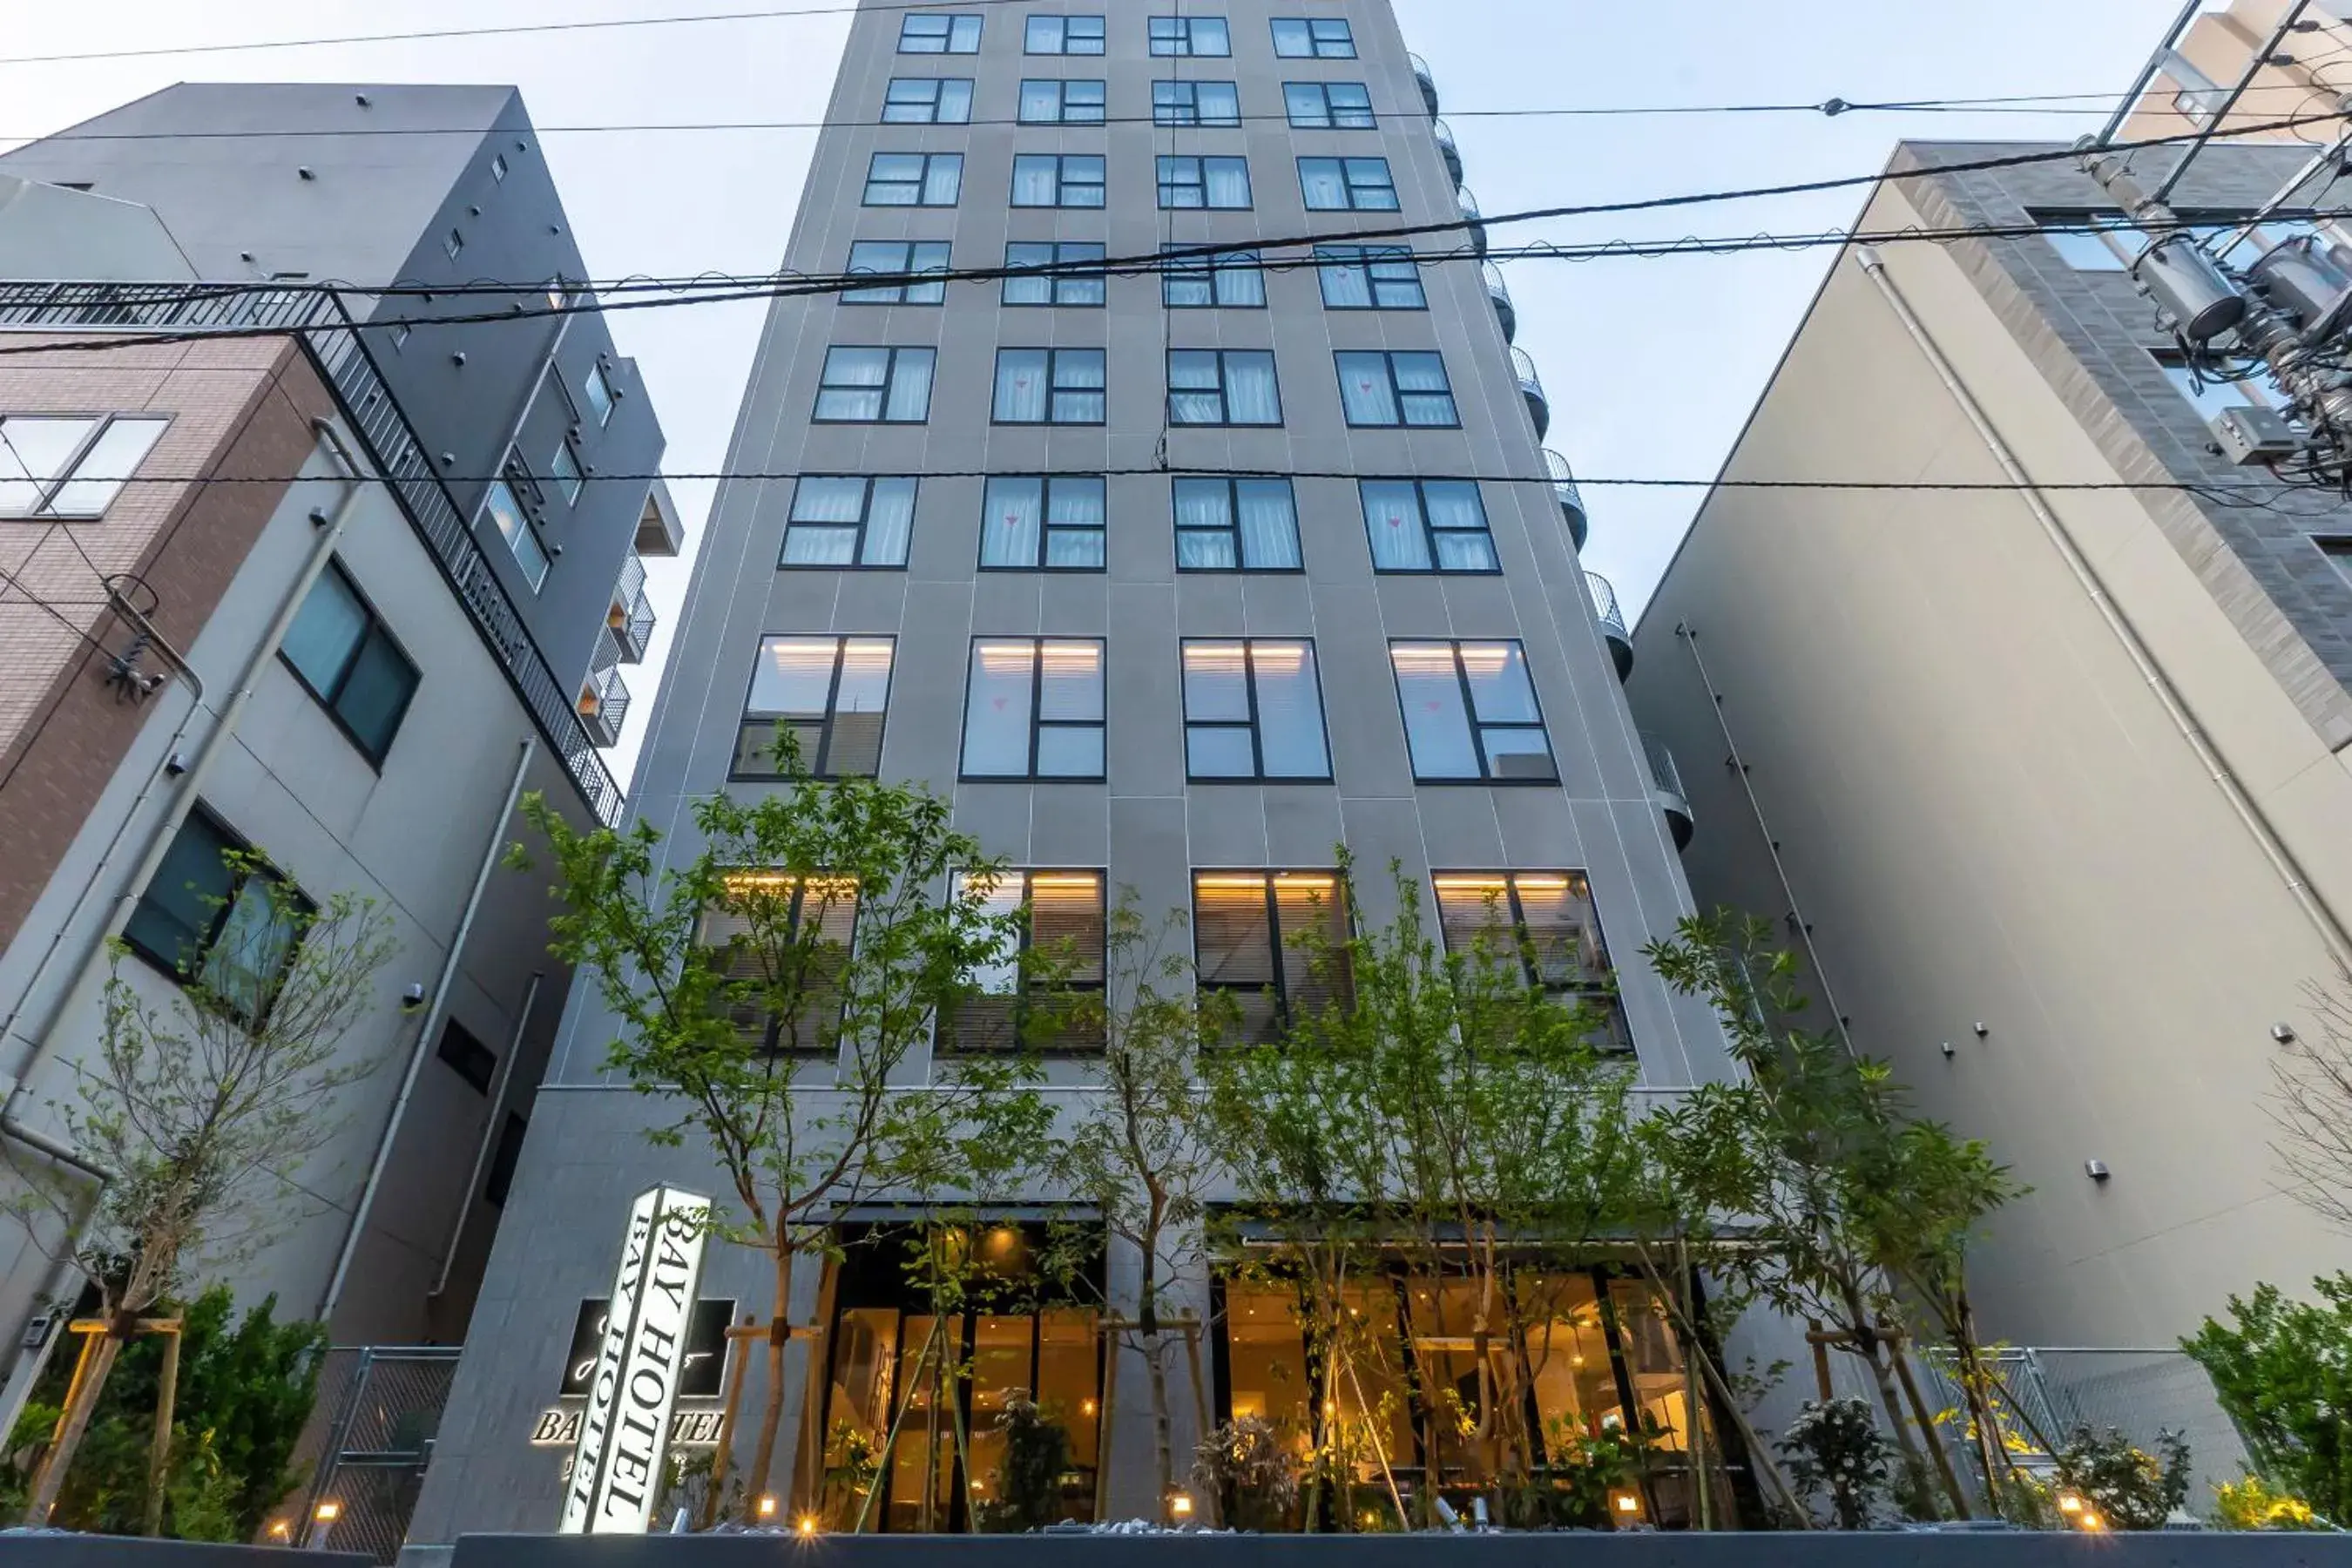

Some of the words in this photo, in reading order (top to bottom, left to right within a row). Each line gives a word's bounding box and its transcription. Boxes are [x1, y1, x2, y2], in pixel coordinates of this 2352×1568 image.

[621, 1214, 650, 1301] BAY
[652, 1204, 700, 1313] BAY
[531, 1411, 580, 1440] BA
[570, 1327, 625, 1517] HOTEL
[605, 1317, 676, 1517] HOTEL
